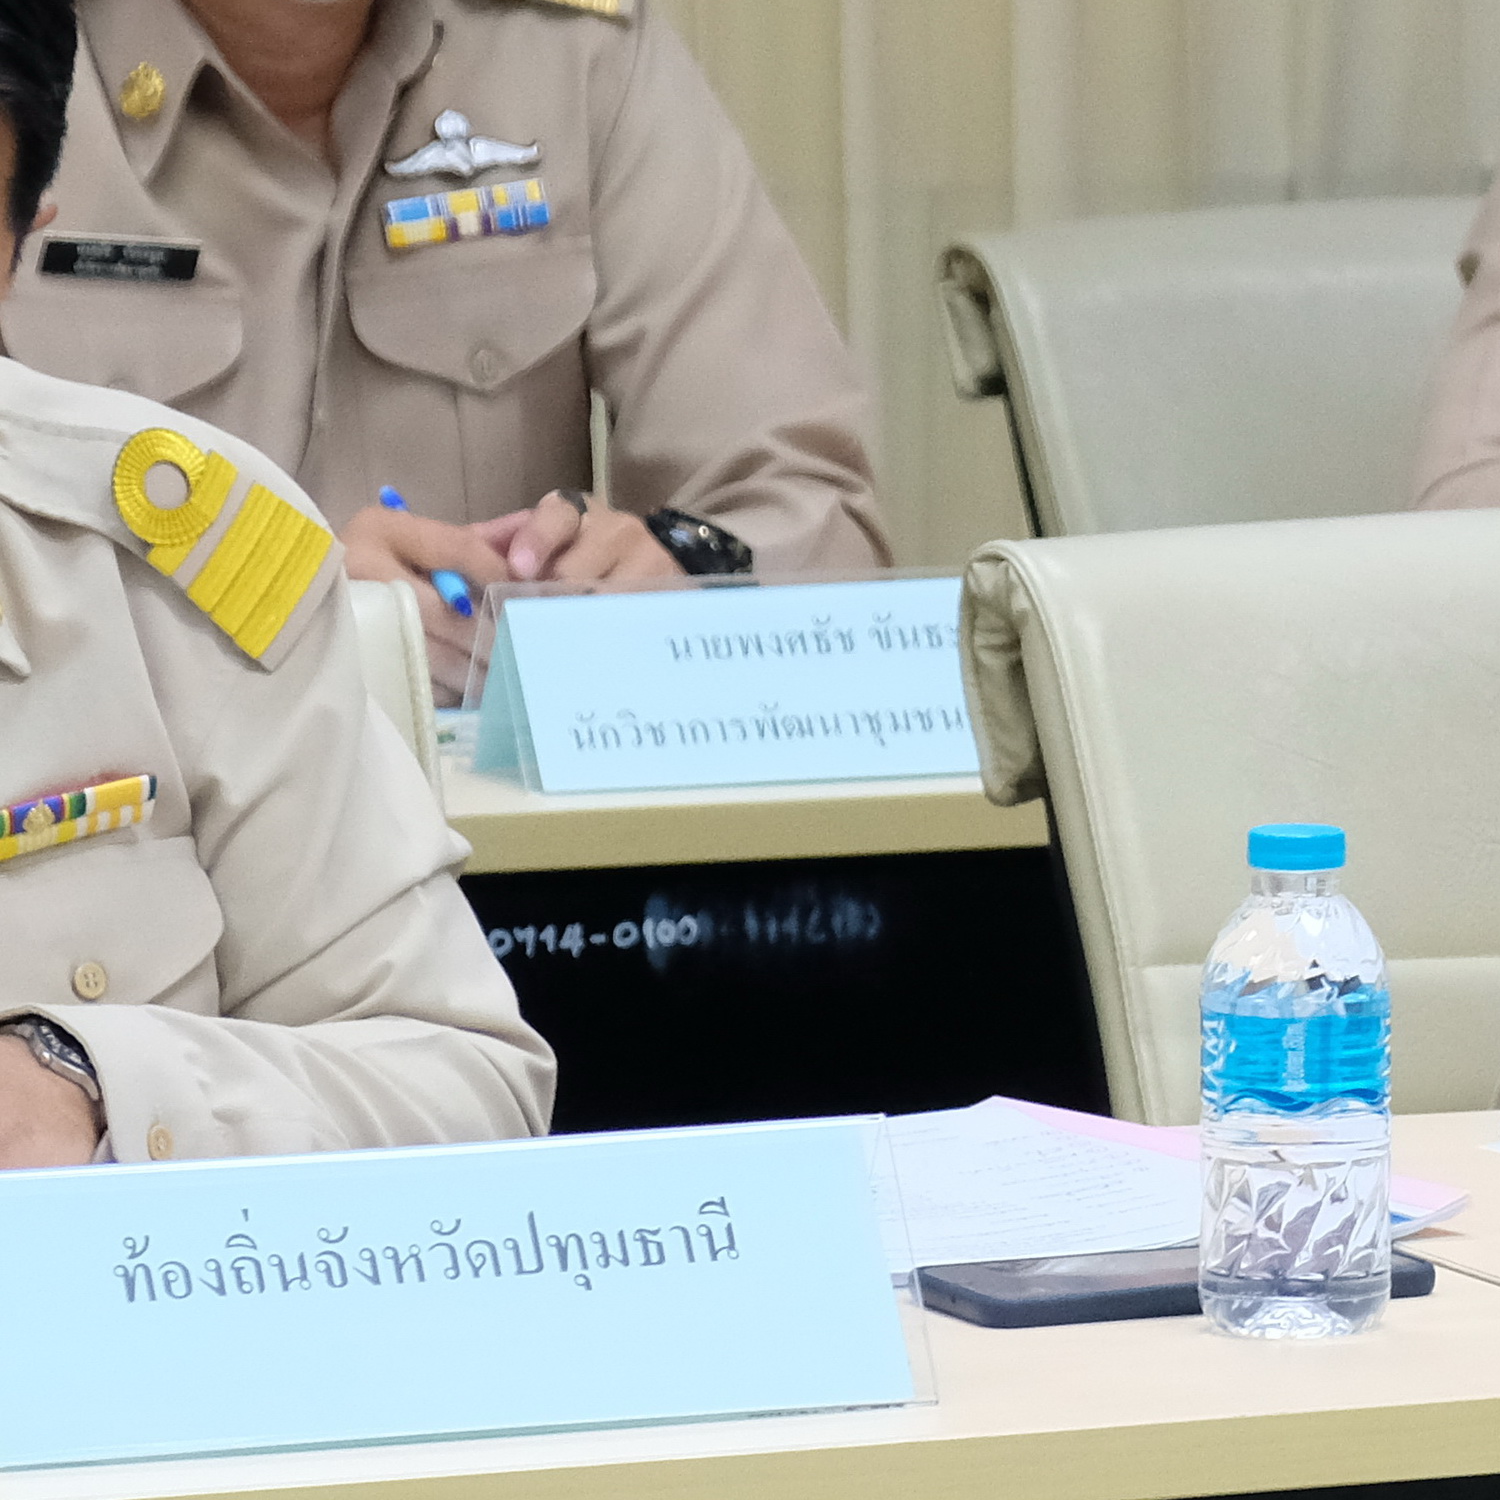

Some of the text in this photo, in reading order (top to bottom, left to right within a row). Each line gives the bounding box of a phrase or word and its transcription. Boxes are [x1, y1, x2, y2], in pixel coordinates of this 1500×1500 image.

[568, 702, 964, 751] นักวิชาการพัฒนาชุมชน
[113, 1196, 741, 1304] ท้องถิ่นจังหวัดปทุมธานี
